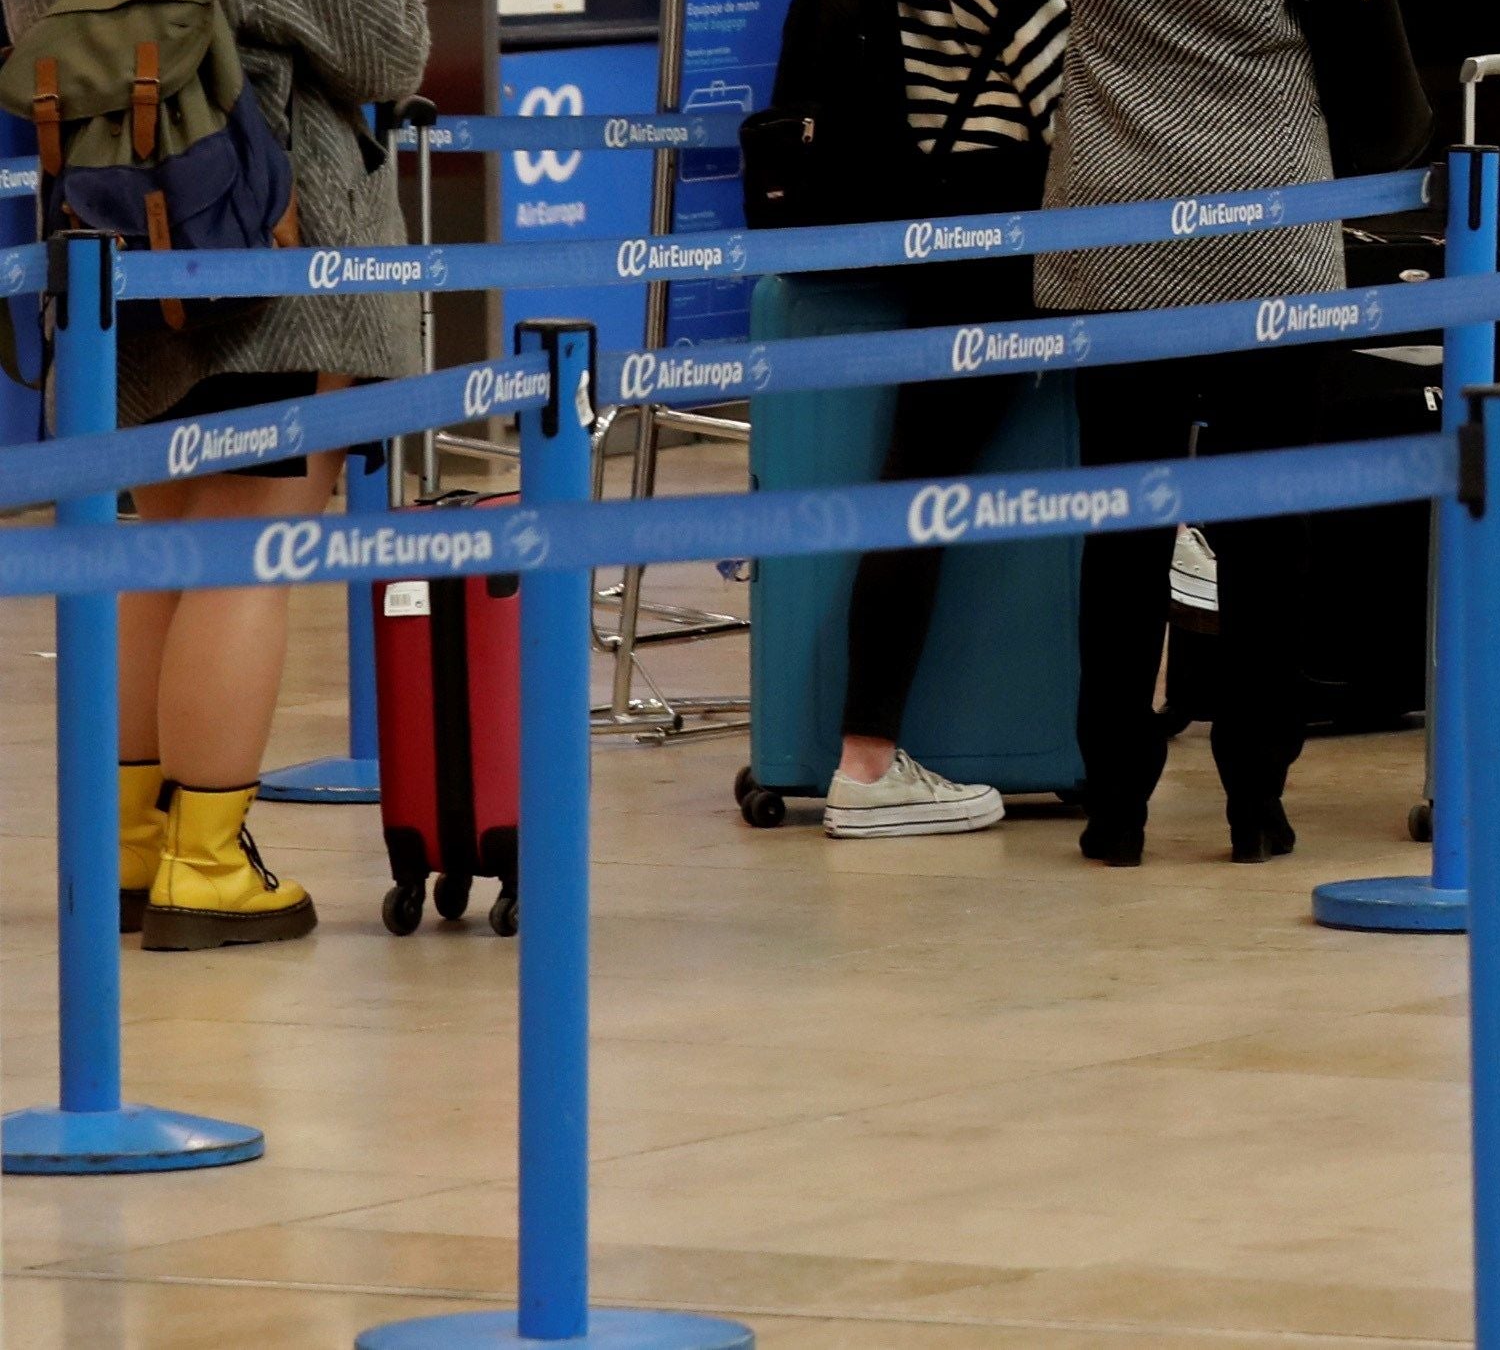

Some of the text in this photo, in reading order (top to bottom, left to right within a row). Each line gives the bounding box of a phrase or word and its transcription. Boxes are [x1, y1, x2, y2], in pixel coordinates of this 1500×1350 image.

[736, 1, 760, 12] mano
[629, 123, 689, 145] AirEuropa
[516, 201, 587, 227] AirEuropa
[1198, 202, 1264, 227] AirEuropa
[933, 226, 1002, 251] AirEuropa
[342, 256, 422, 285] AirEuropa
[648, 244, 723, 271] AirEuropa
[1286, 303, 1360, 331] AirEuropa
[985, 332, 1065, 362] AirEuropa
[656, 359, 744, 390] AirEuropa
[200, 424, 278, 461] AirEuropa
[973, 488, 1130, 528] AirEuropa
[325, 528, 493, 569] AirEuropa
